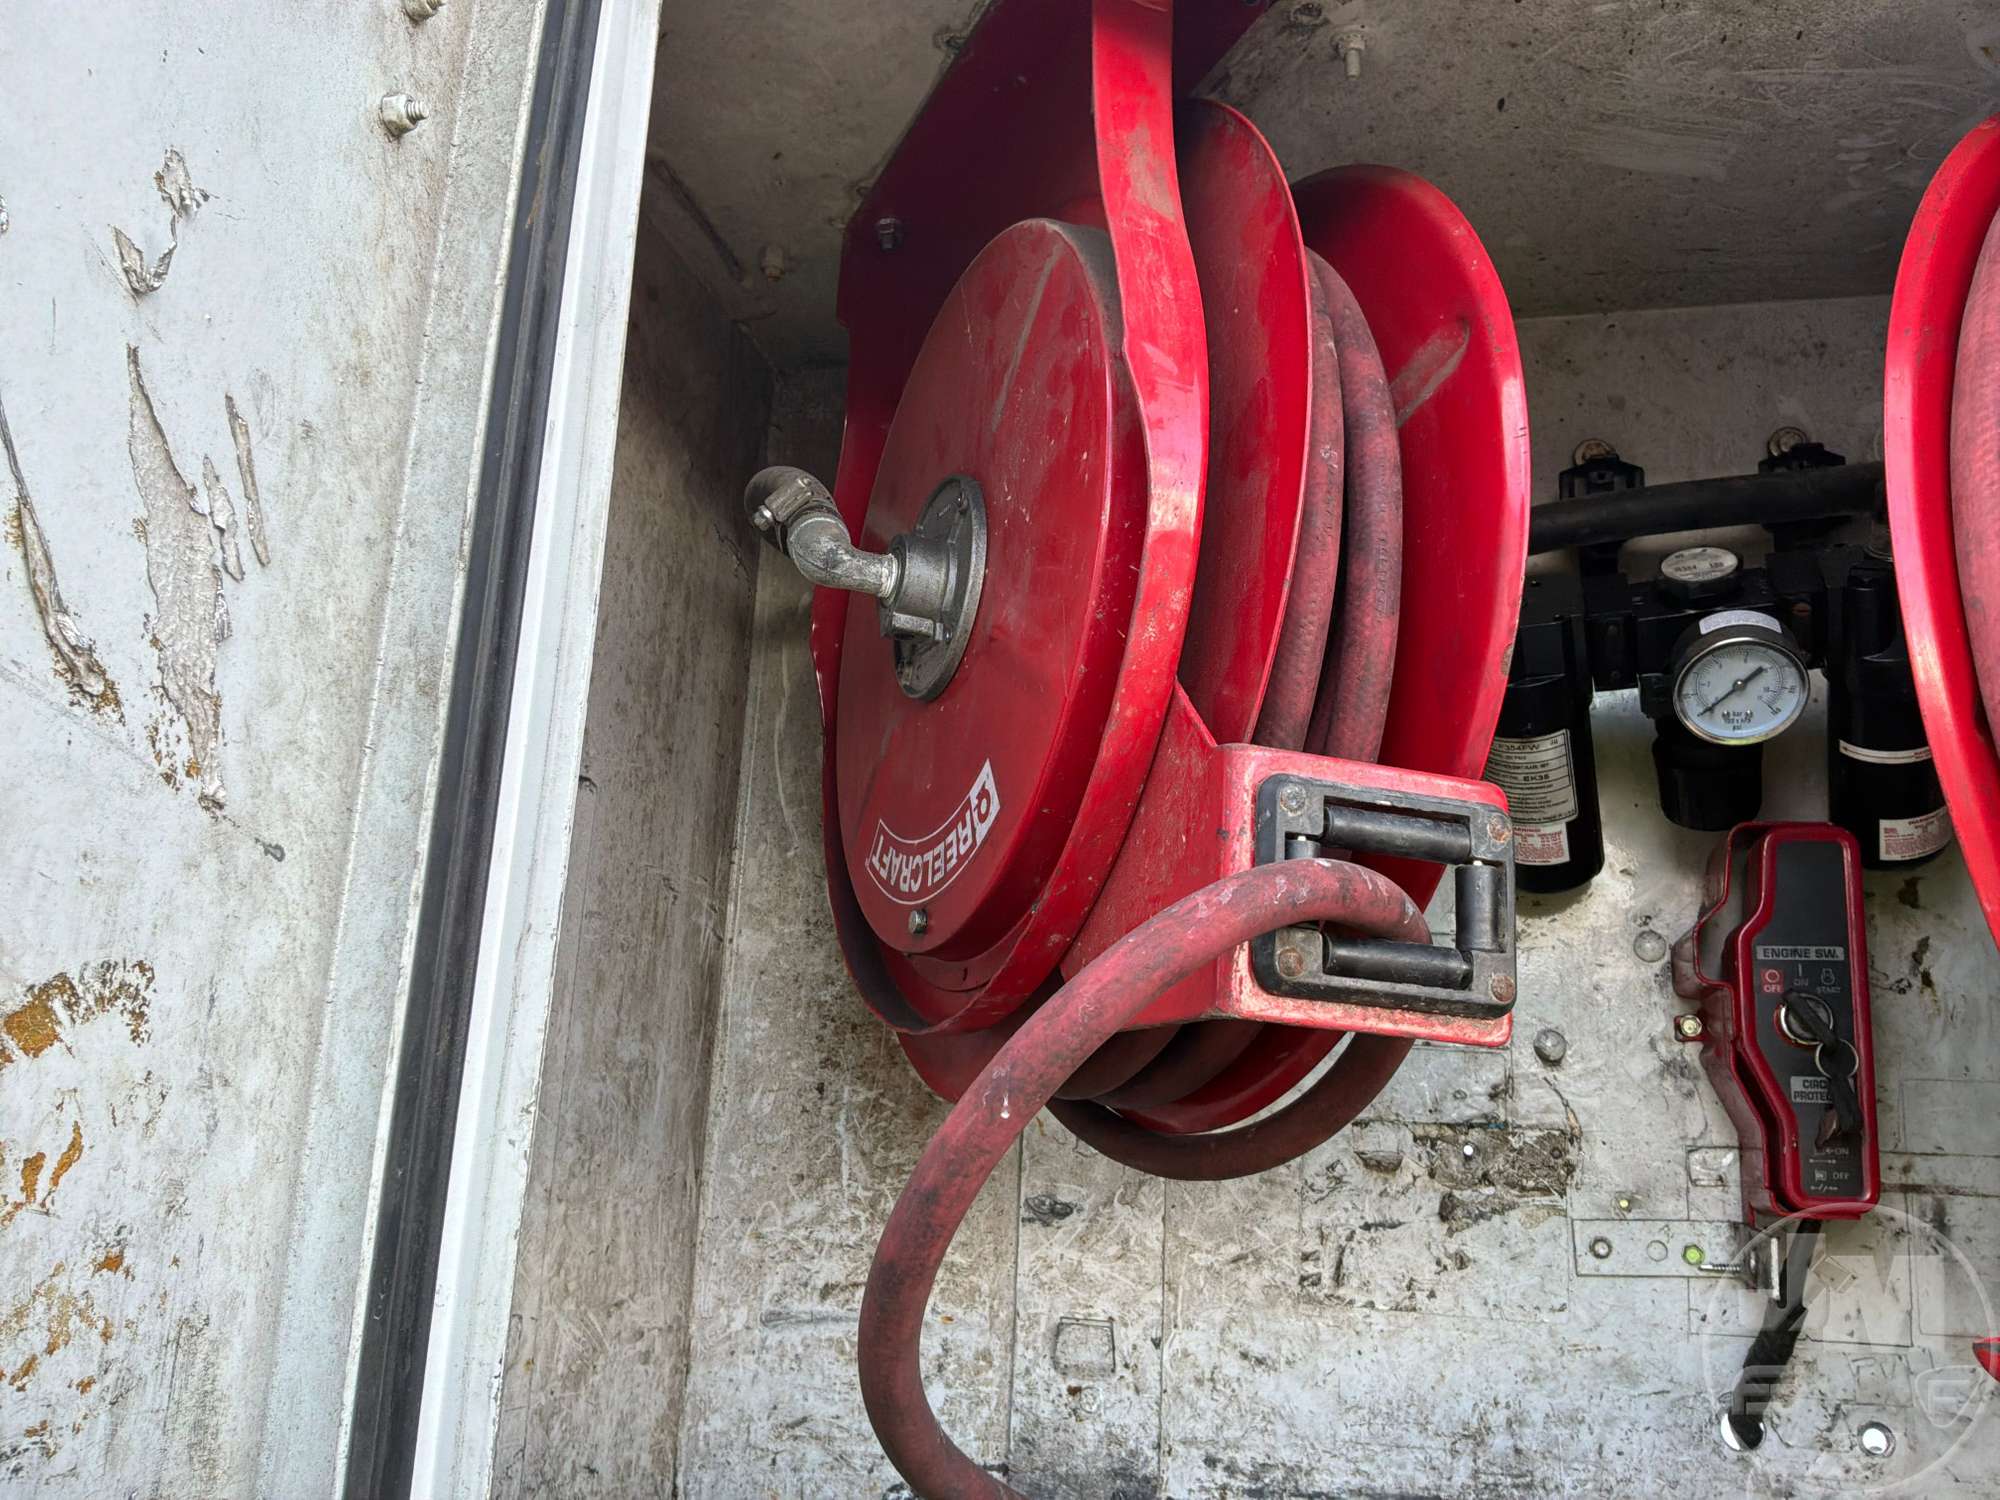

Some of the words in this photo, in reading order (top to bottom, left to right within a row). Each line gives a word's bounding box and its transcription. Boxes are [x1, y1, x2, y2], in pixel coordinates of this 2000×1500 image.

[872, 808, 973, 893] REELCRAFT
[1763, 947, 1811, 959] ENGINE
[1815, 947, 1839, 959] SW.
[1793, 978, 1809, 986] ON
[1763, 984, 1781, 993] OFF
[1802, 1079, 1828, 1089] CIRC
[1835, 1147, 1849, 1155] ON
[1833, 1172, 1849, 1180] OFF
